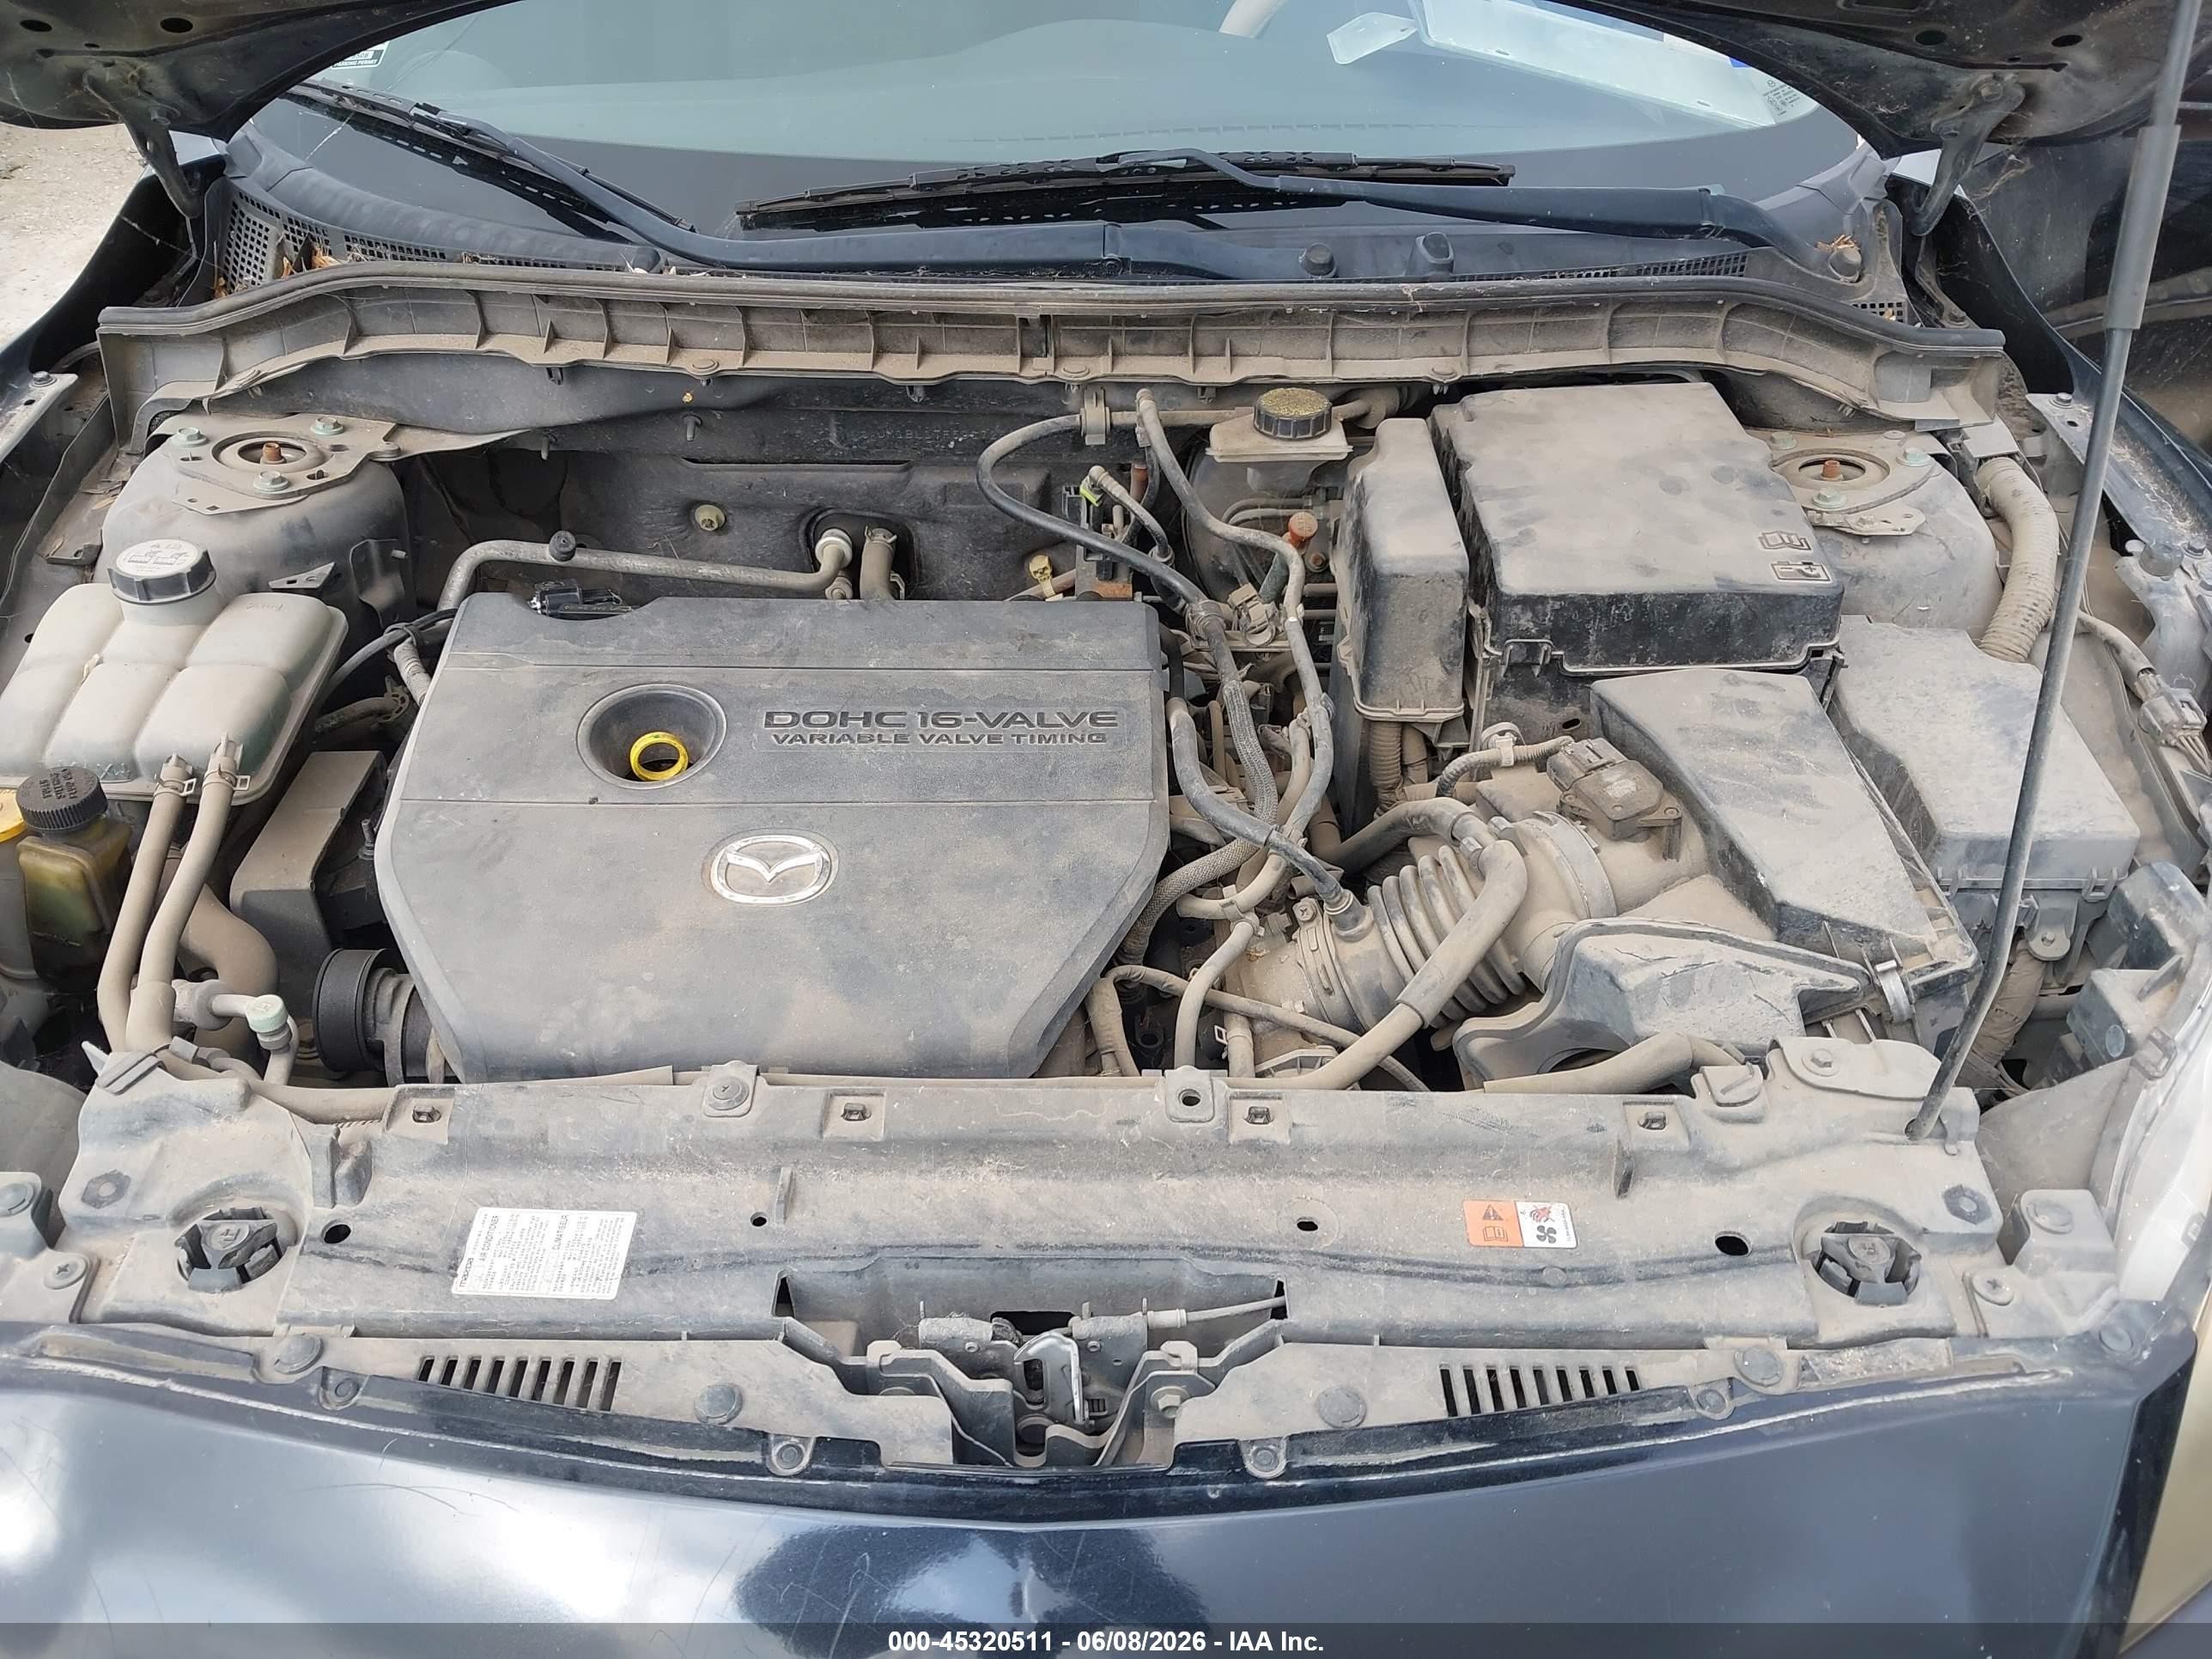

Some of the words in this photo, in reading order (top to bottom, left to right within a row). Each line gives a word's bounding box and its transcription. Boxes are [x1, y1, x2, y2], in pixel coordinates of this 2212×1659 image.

[763, 711, 908, 728] DOHC
[917, 711, 1118, 728] 16-VALVE
[773, 733, 910, 745] VARIABLE
[920, 733, 1003, 745] VALVE
[1012, 733, 1107, 744] TIMING
[481, 1215, 500, 1250] CONDITIONER
[459, 1258, 473, 1287] mazda
